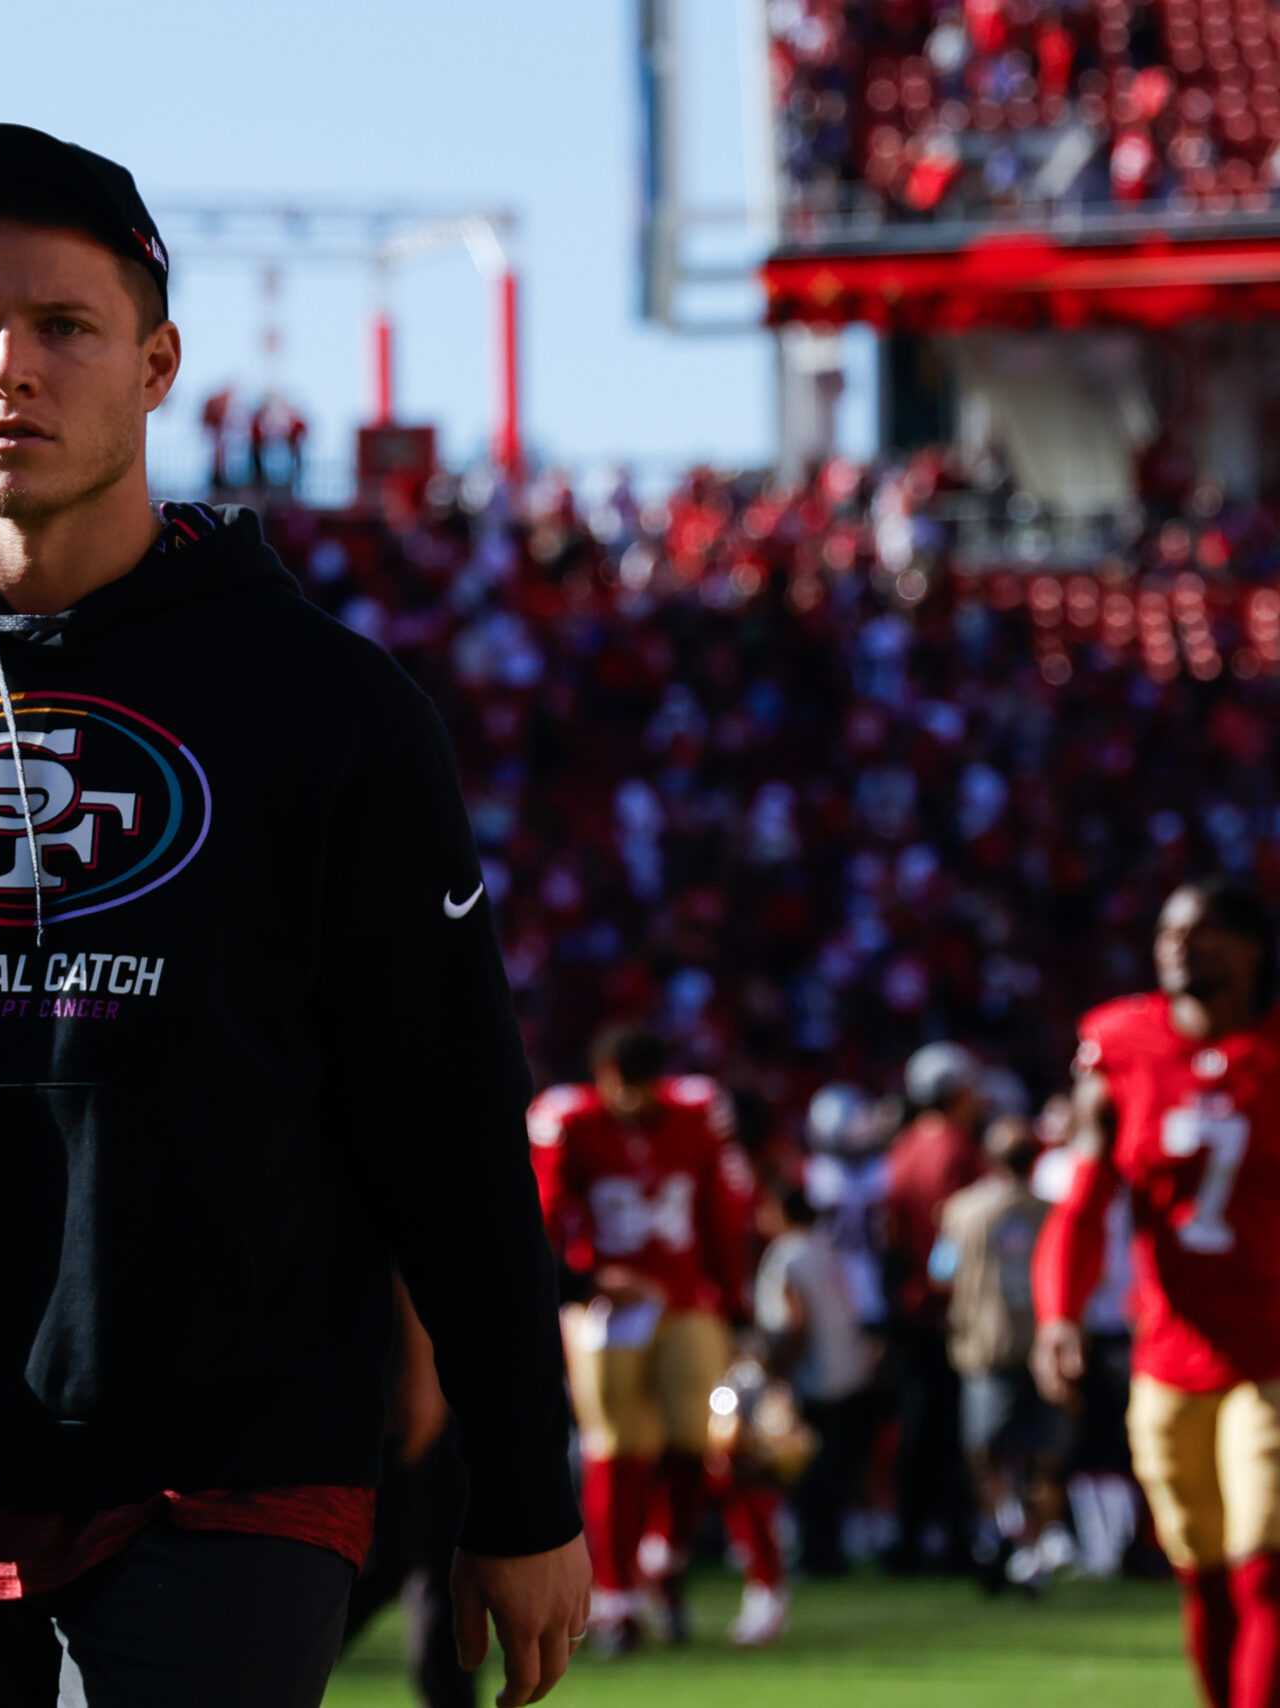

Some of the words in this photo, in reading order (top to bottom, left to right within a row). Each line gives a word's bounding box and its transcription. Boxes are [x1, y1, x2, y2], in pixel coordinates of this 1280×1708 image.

[44, 953, 165, 996] CATCH
[39, 998, 120, 1020] CANCER
[1161, 1106, 1250, 1253] 7
